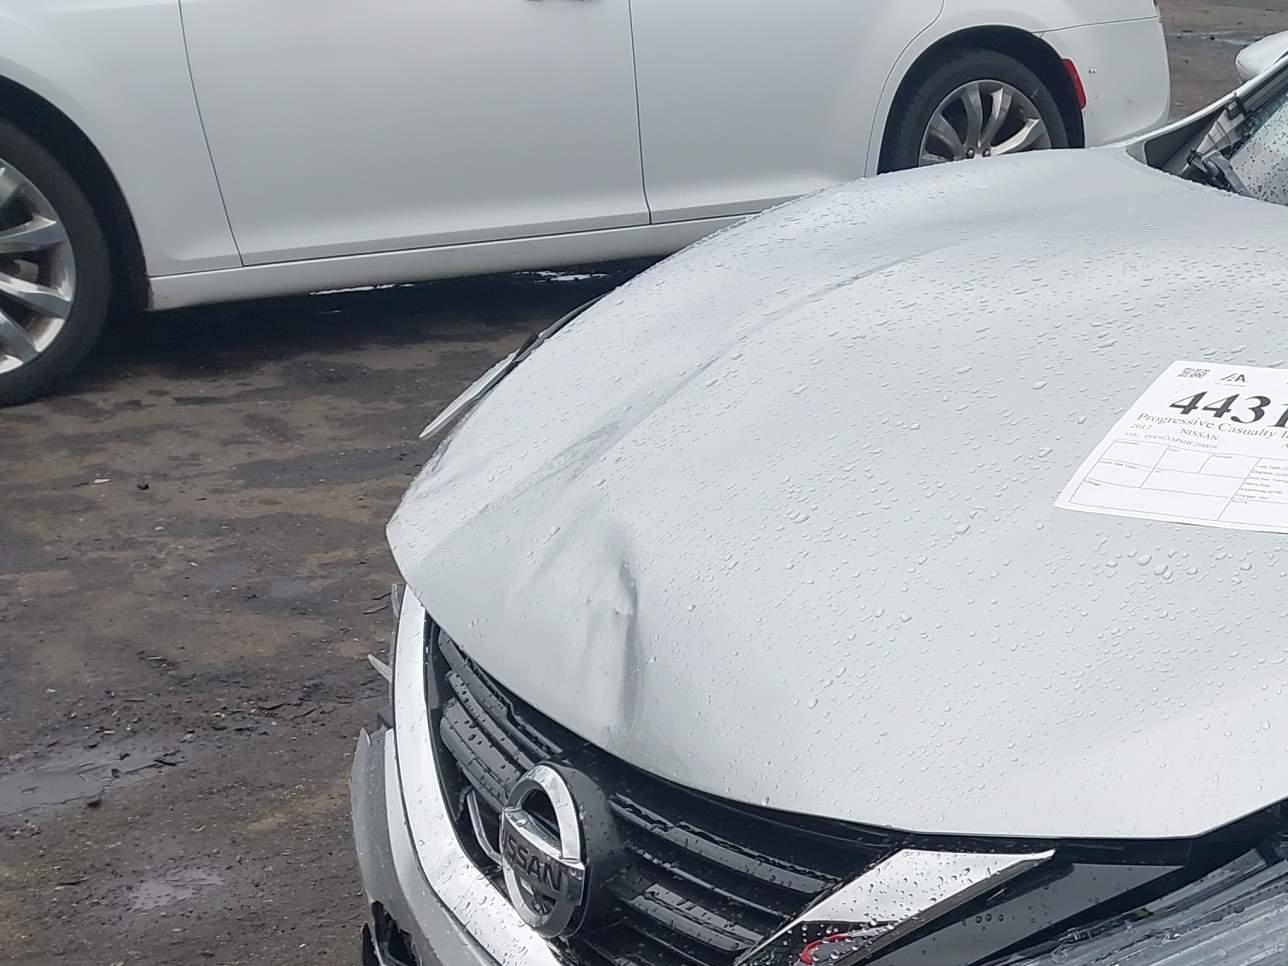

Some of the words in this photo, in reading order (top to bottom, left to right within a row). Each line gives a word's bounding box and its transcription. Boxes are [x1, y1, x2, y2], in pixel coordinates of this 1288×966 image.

[1137, 413, 1215, 429] Progressive
[1218, 422, 1277, 439] Casualty
[1180, 428, 1220, 440] NISSAN
